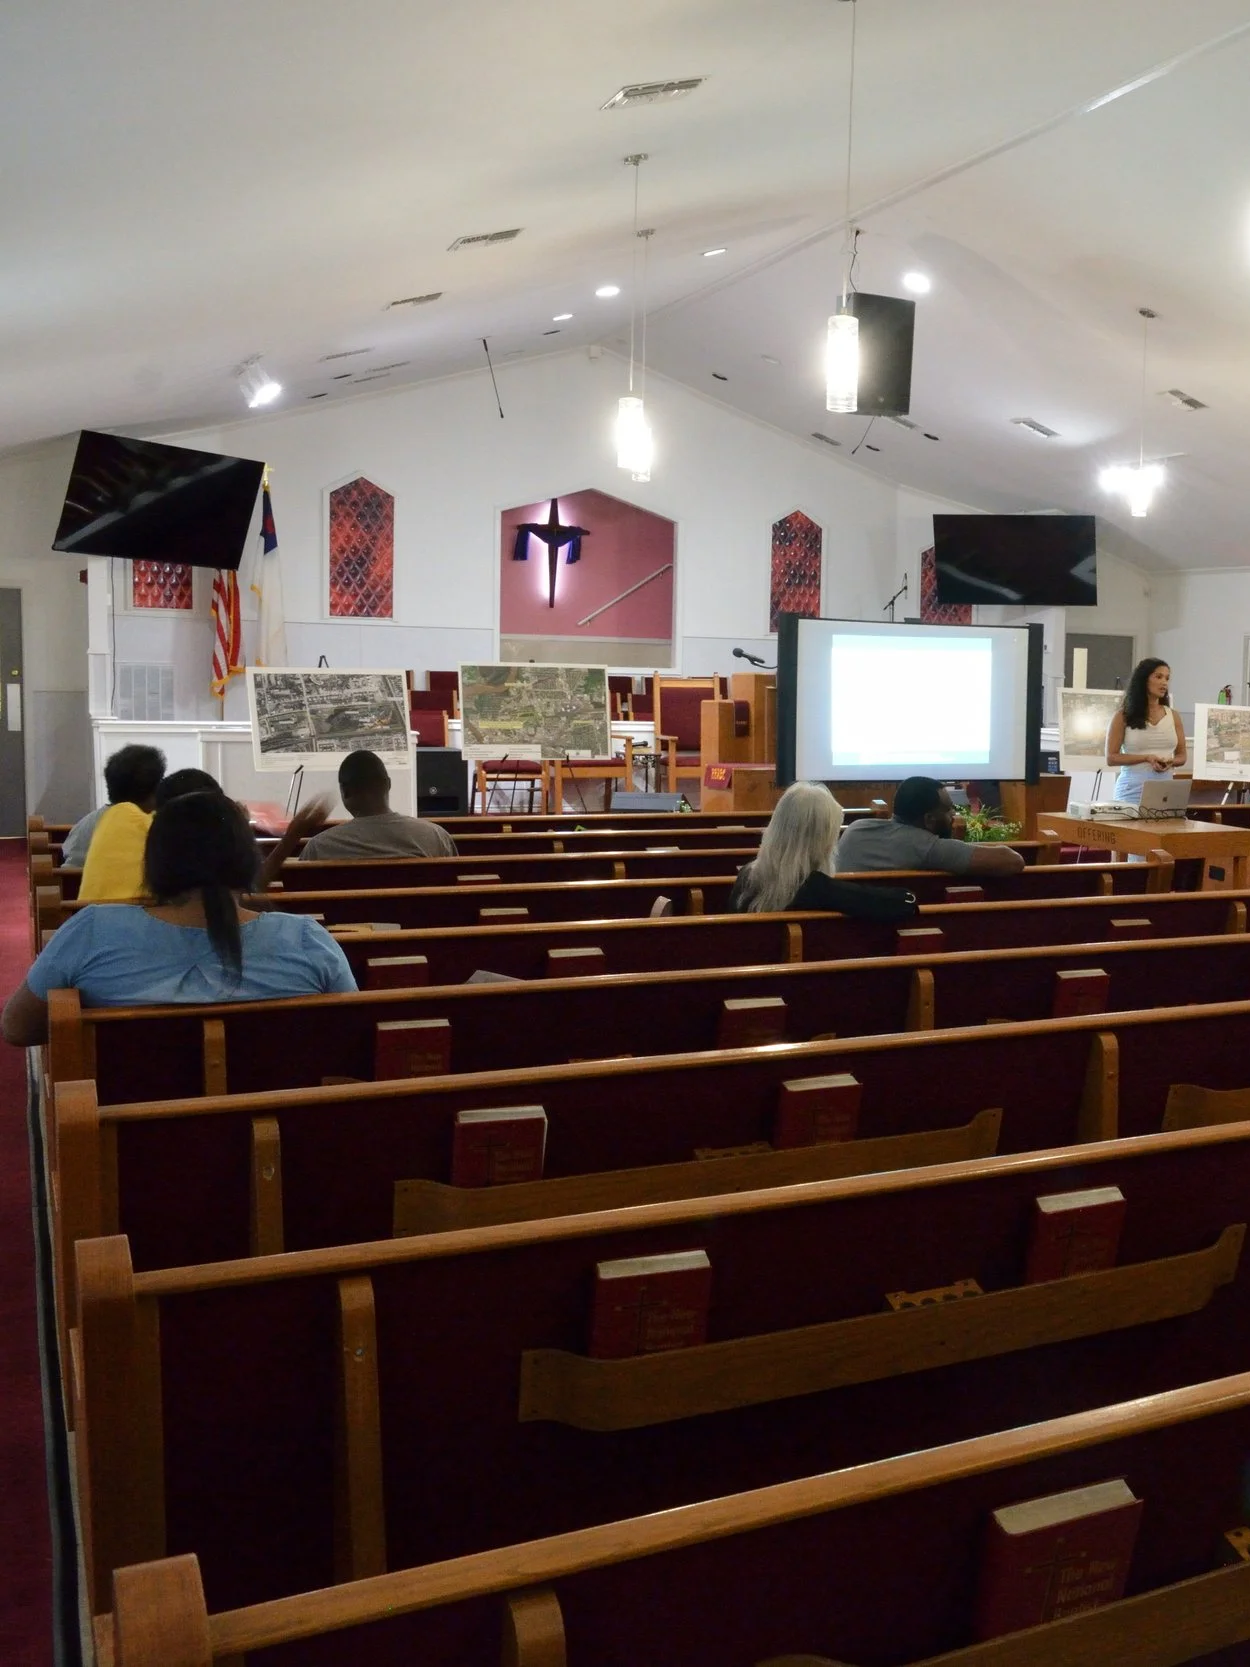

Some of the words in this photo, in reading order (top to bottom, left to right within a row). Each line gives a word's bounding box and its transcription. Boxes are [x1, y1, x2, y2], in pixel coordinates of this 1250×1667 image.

[1077, 826, 1116, 844] OFFERING
[1060, 1566, 1084, 1584] The
[1055, 1573, 1115, 1604] National
